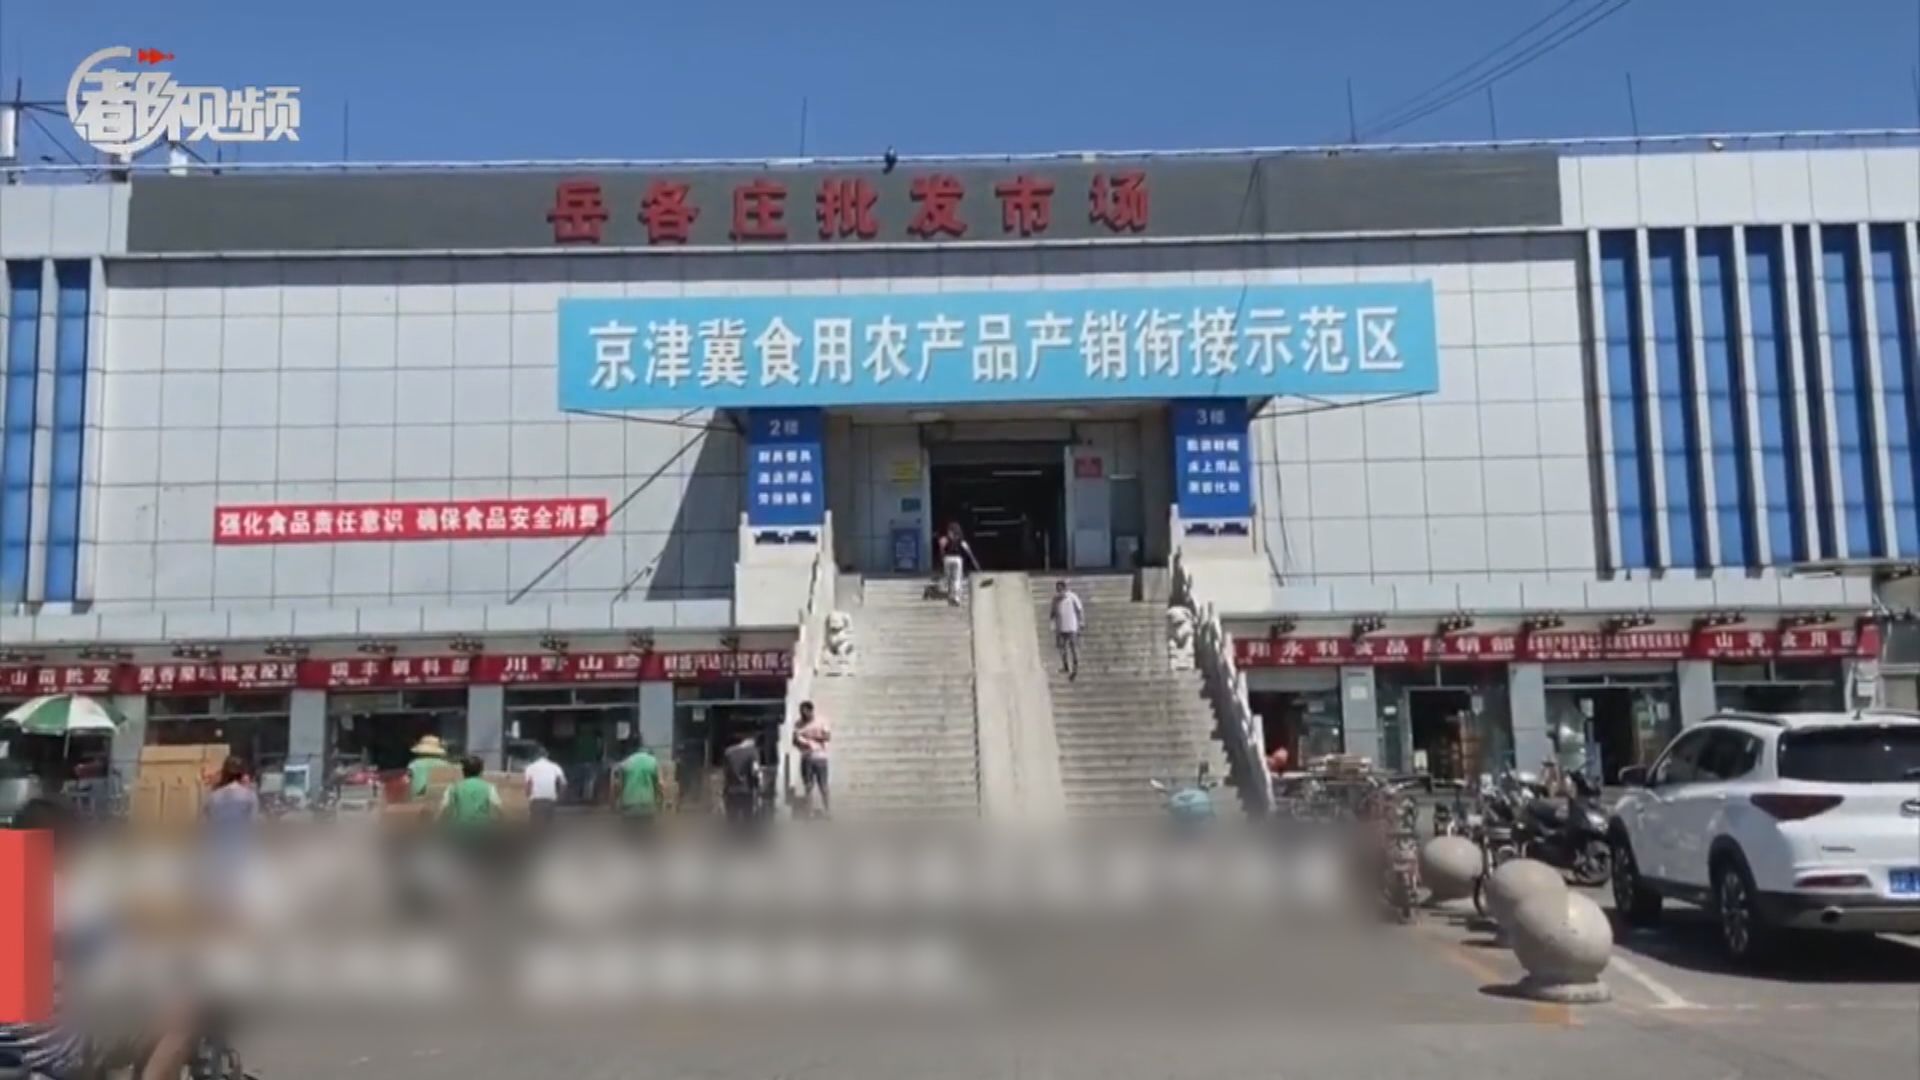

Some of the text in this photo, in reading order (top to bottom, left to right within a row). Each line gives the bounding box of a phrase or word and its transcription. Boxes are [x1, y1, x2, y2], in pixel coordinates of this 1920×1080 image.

[547, 171, 1151, 244] 岳各庄批发市场
[588, 303, 1404, 391] 京津冀食用农产品产销衔接示范区
[219, 504, 600, 537] 强化食品责任意识 确保食品安全消费
